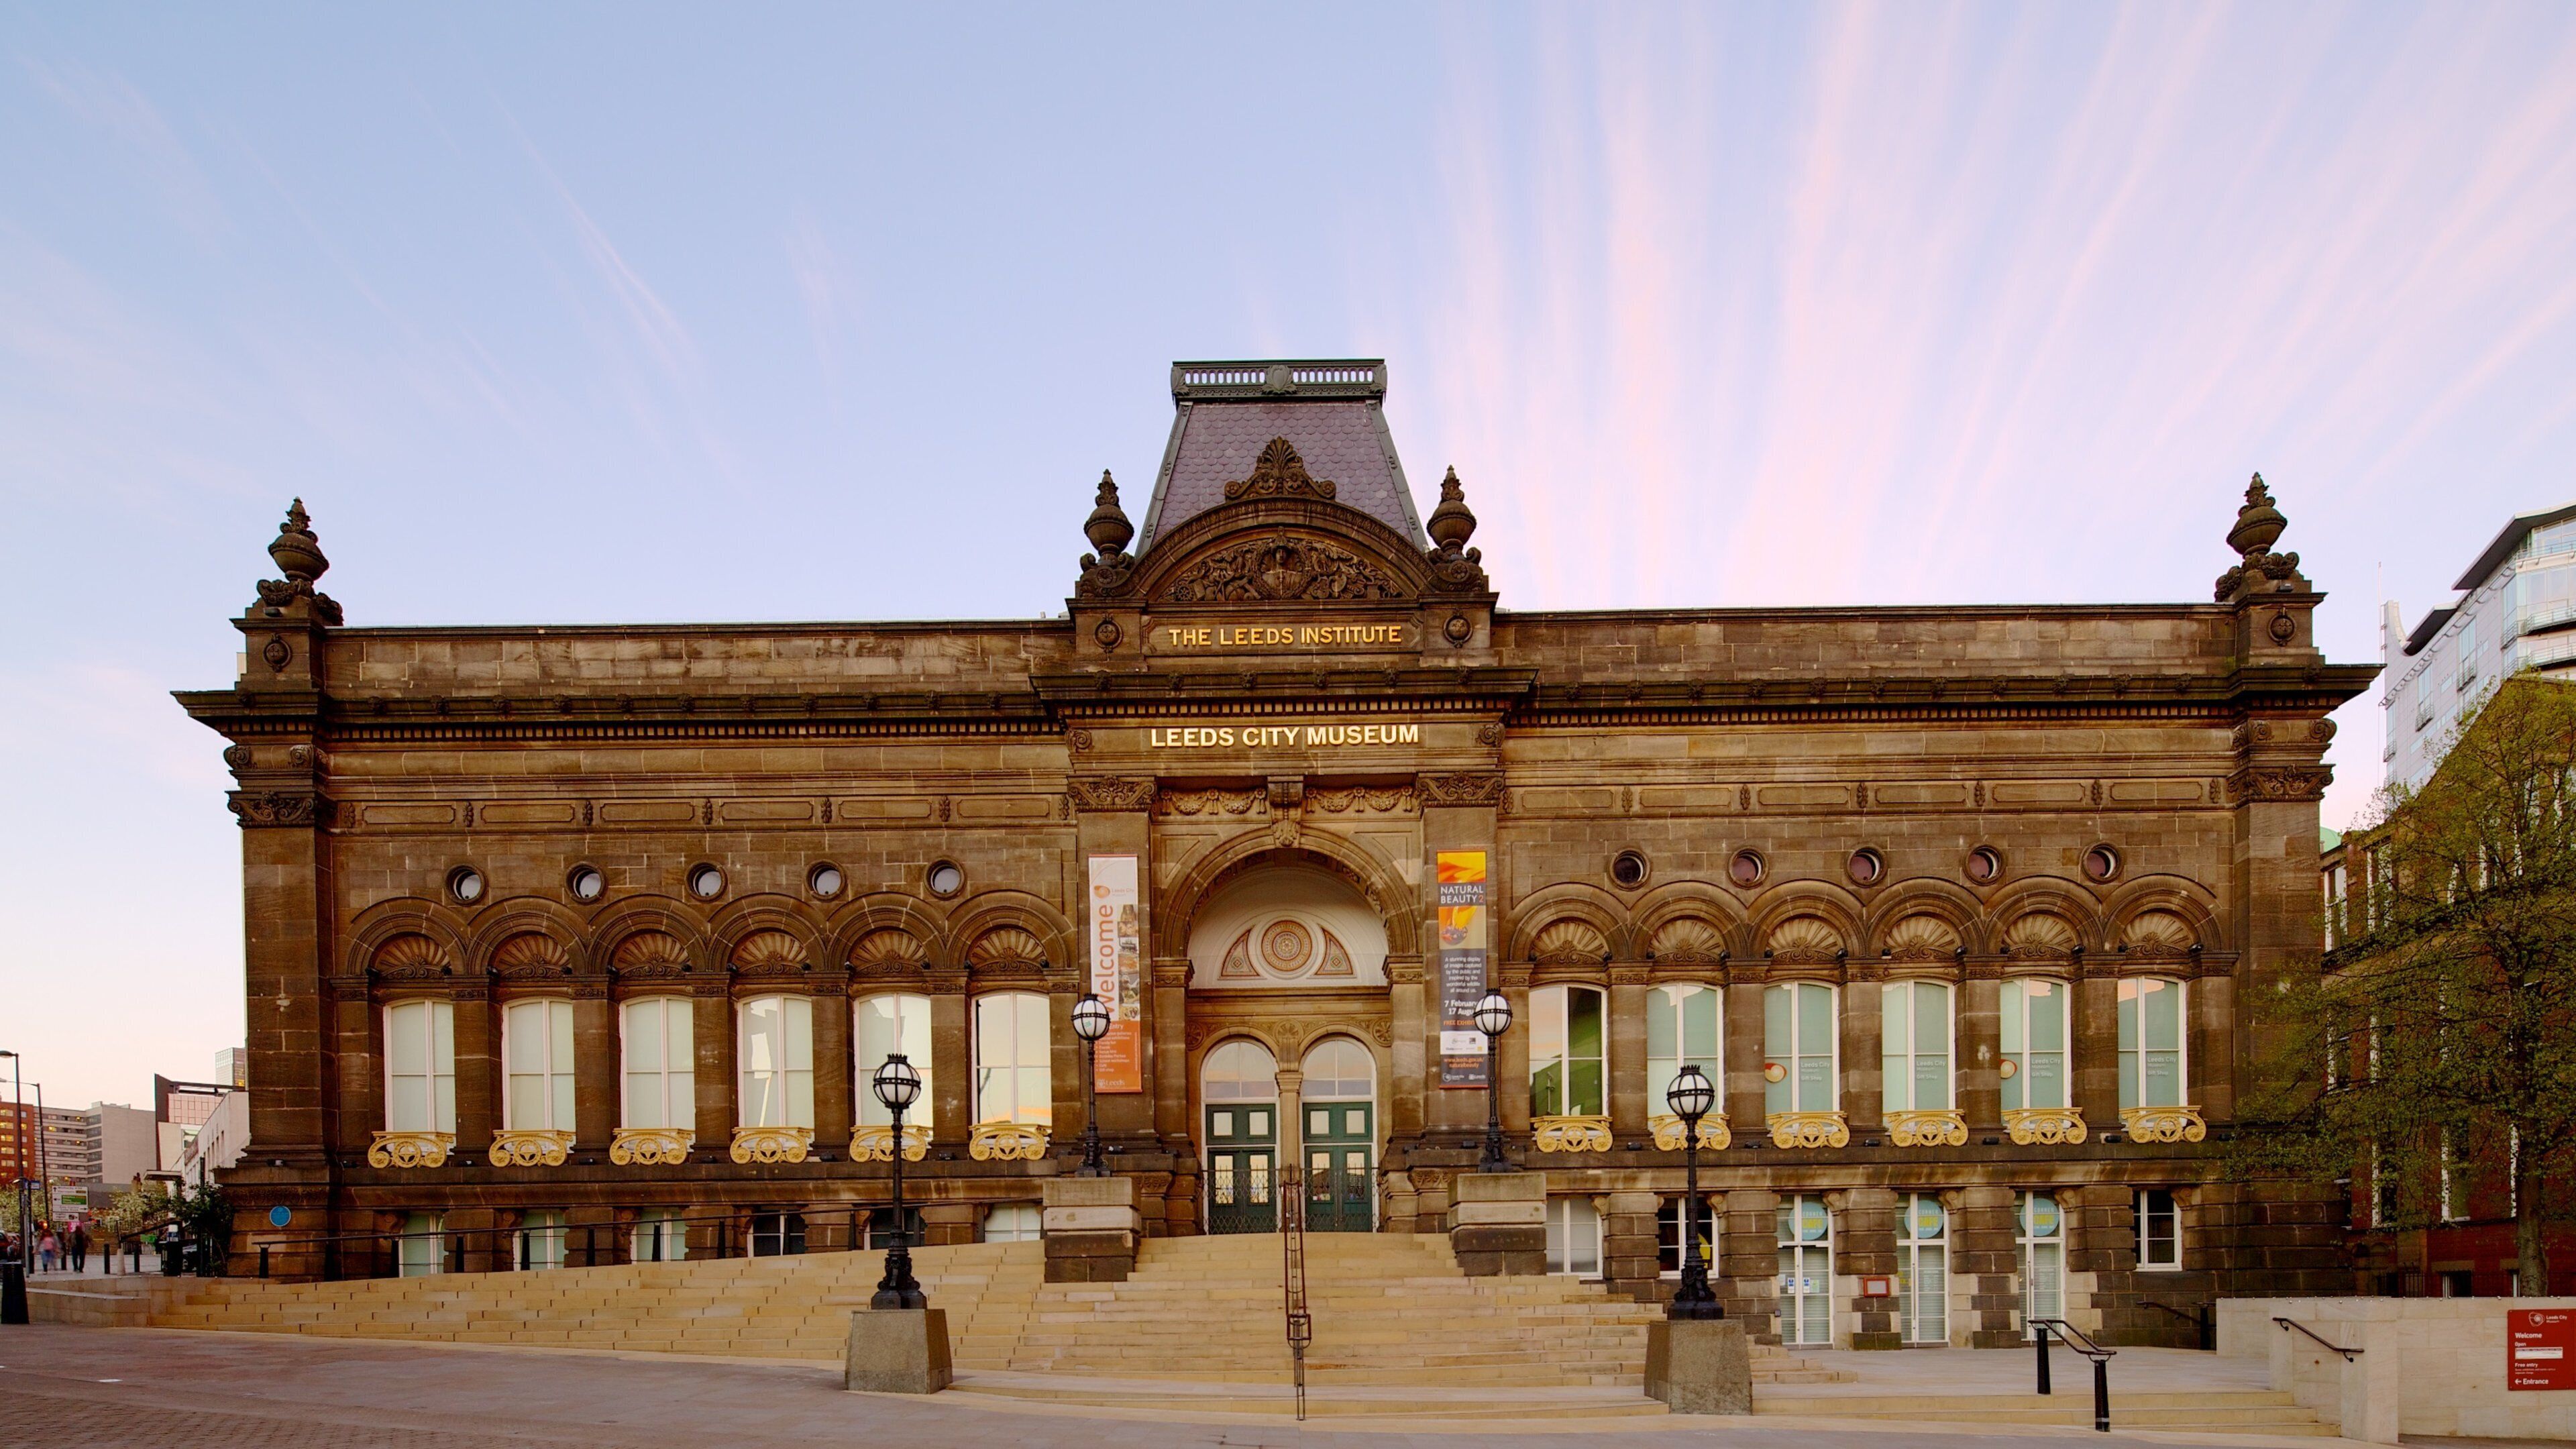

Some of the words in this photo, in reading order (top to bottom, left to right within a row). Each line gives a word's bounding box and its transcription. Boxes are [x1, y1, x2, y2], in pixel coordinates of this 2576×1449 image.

[1169, 629, 1211, 645] THE
[1220, 627, 1293, 645] LEEDS
[1301, 626, 1401, 643] INSTITUTE
[1151, 728, 1234, 747] LEEDS
[1242, 727, 1299, 746] CITY
[1307, 724, 1418, 745] MUSEUM
[1440, 885, 1483, 894] NATURAL
[1440, 895, 1477, 904] BEAUTY
[1479, 895, 1484, 903] 2
[1444, 1000, 1449, 1008] 7
[1450, 999, 1478, 1008] February
[1457, 1008, 1474, 1016] Augu
